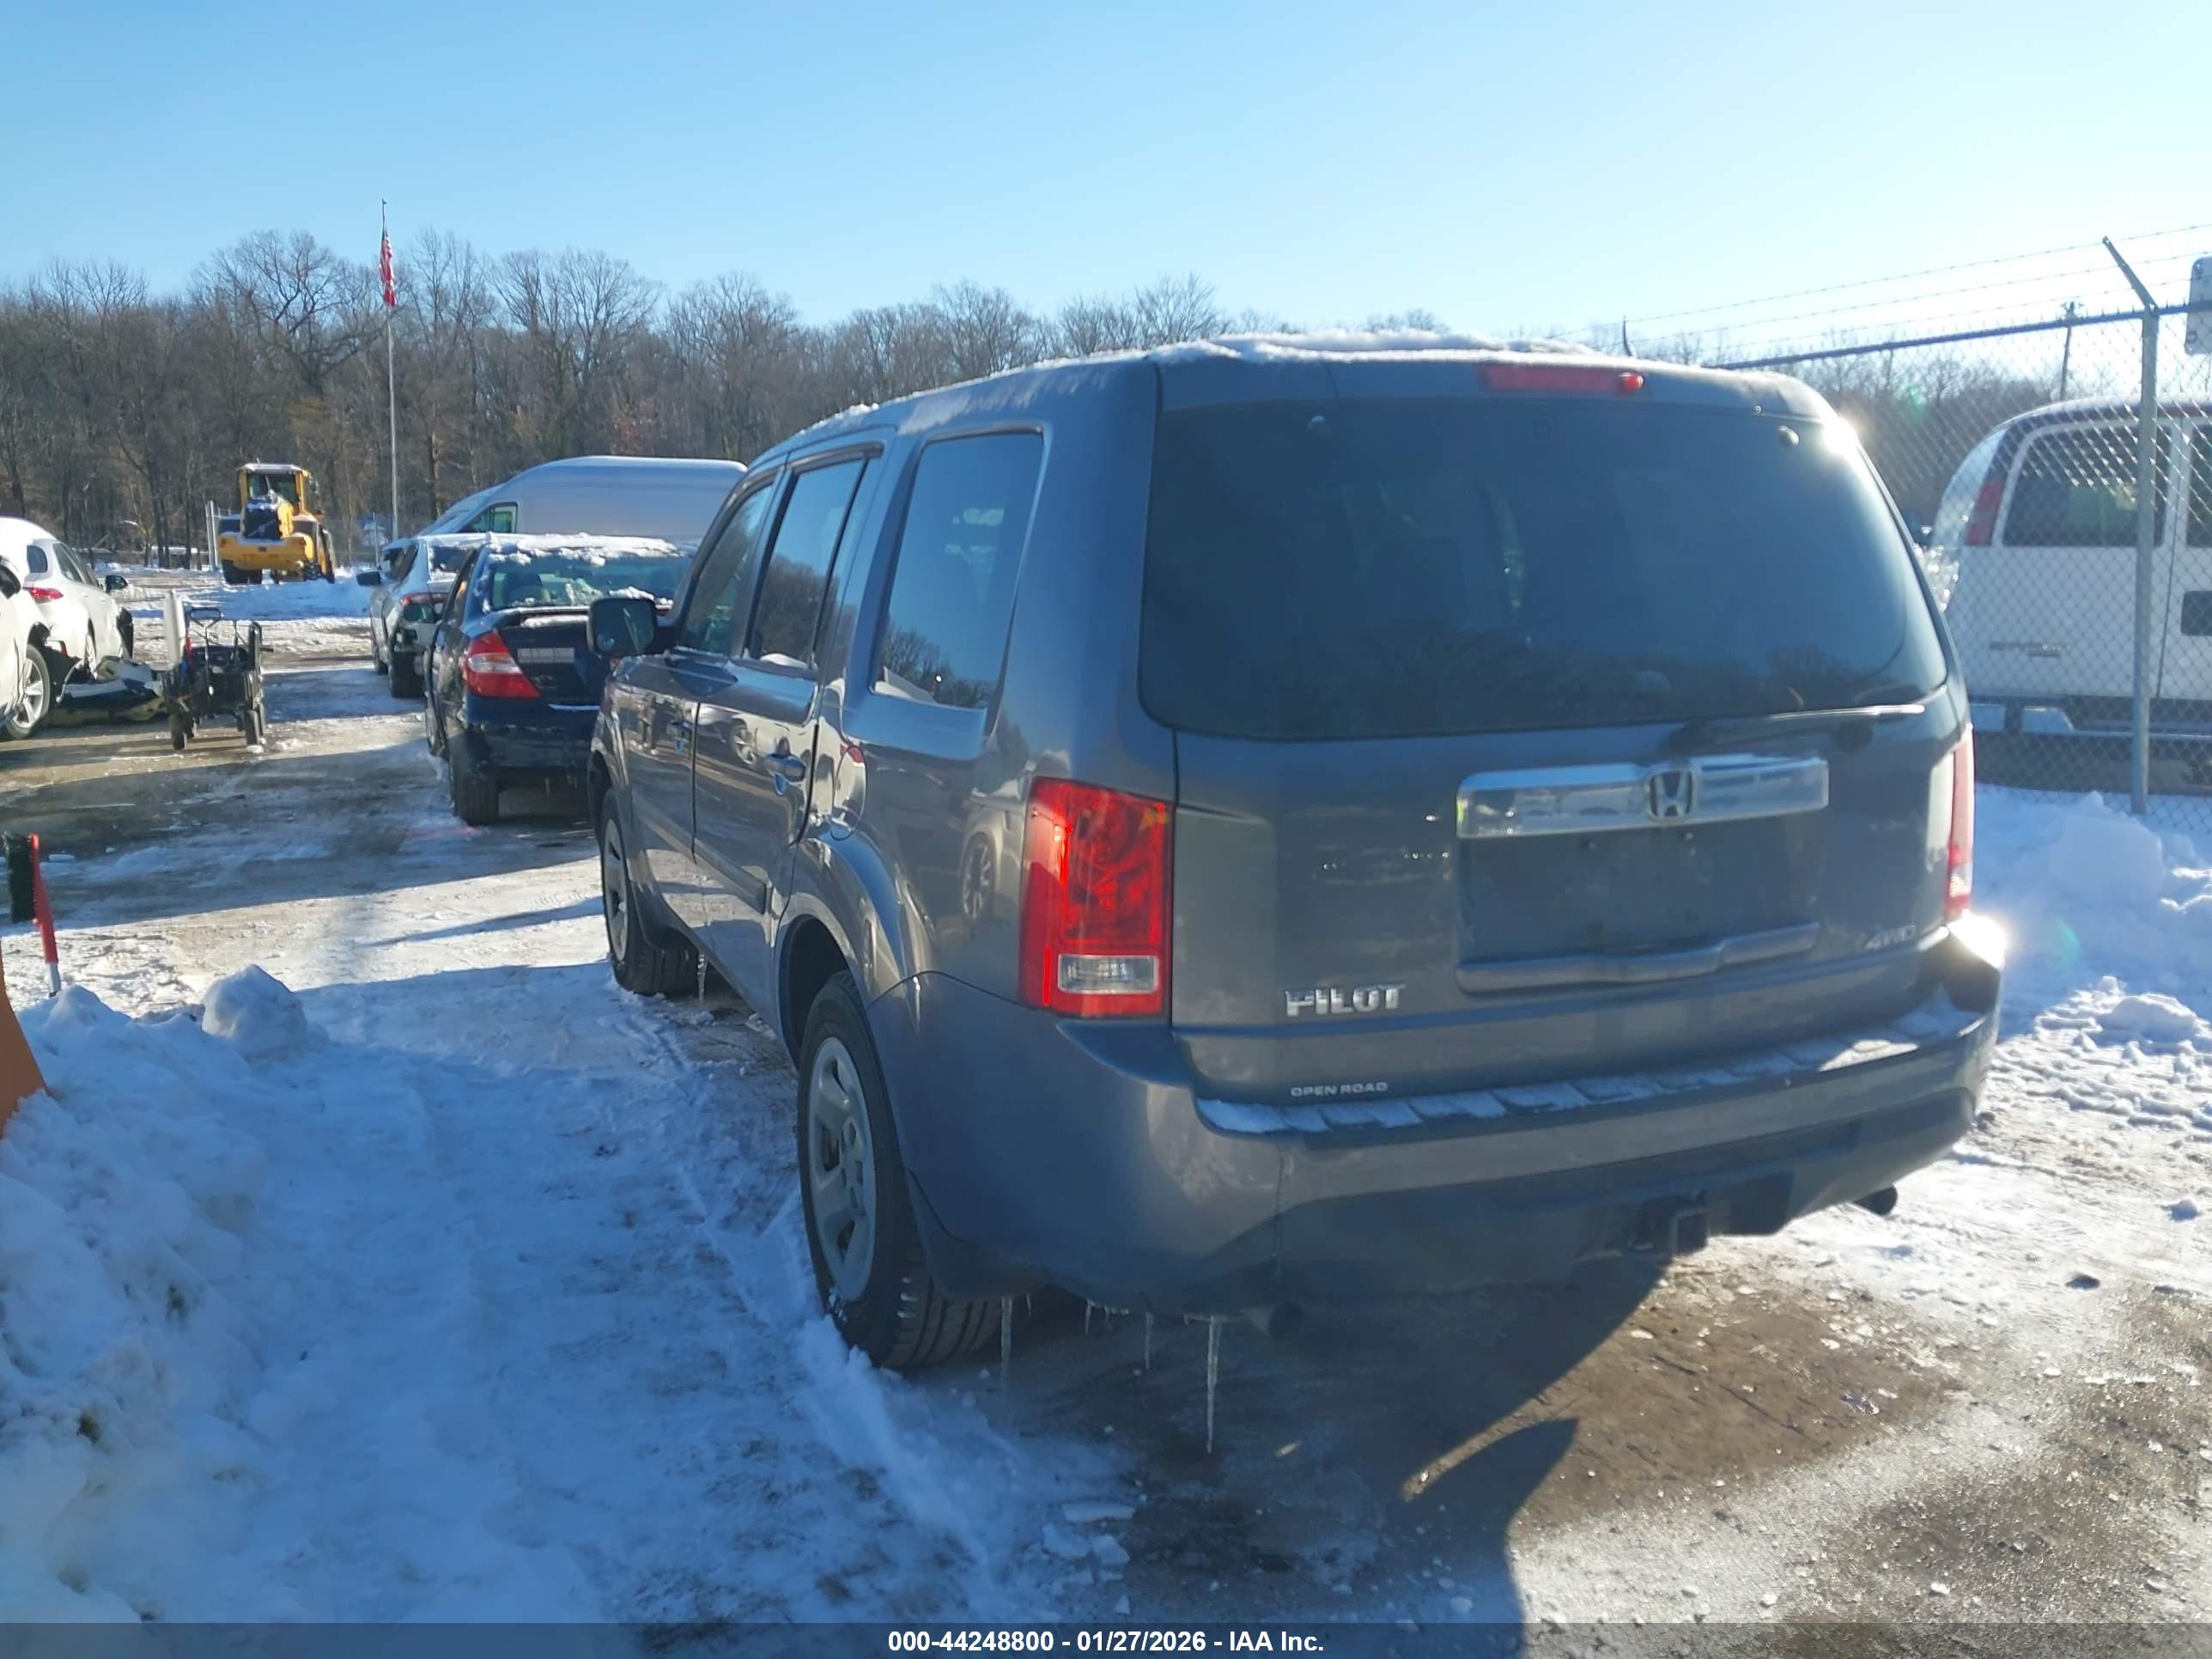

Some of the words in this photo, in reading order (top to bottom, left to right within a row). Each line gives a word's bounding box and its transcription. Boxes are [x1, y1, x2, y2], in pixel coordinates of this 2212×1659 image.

[1285, 984, 1407, 1017] PILOT
[1291, 1084, 1337, 1097] OPEN
[1340, 1081, 1389, 1095] ROAD
